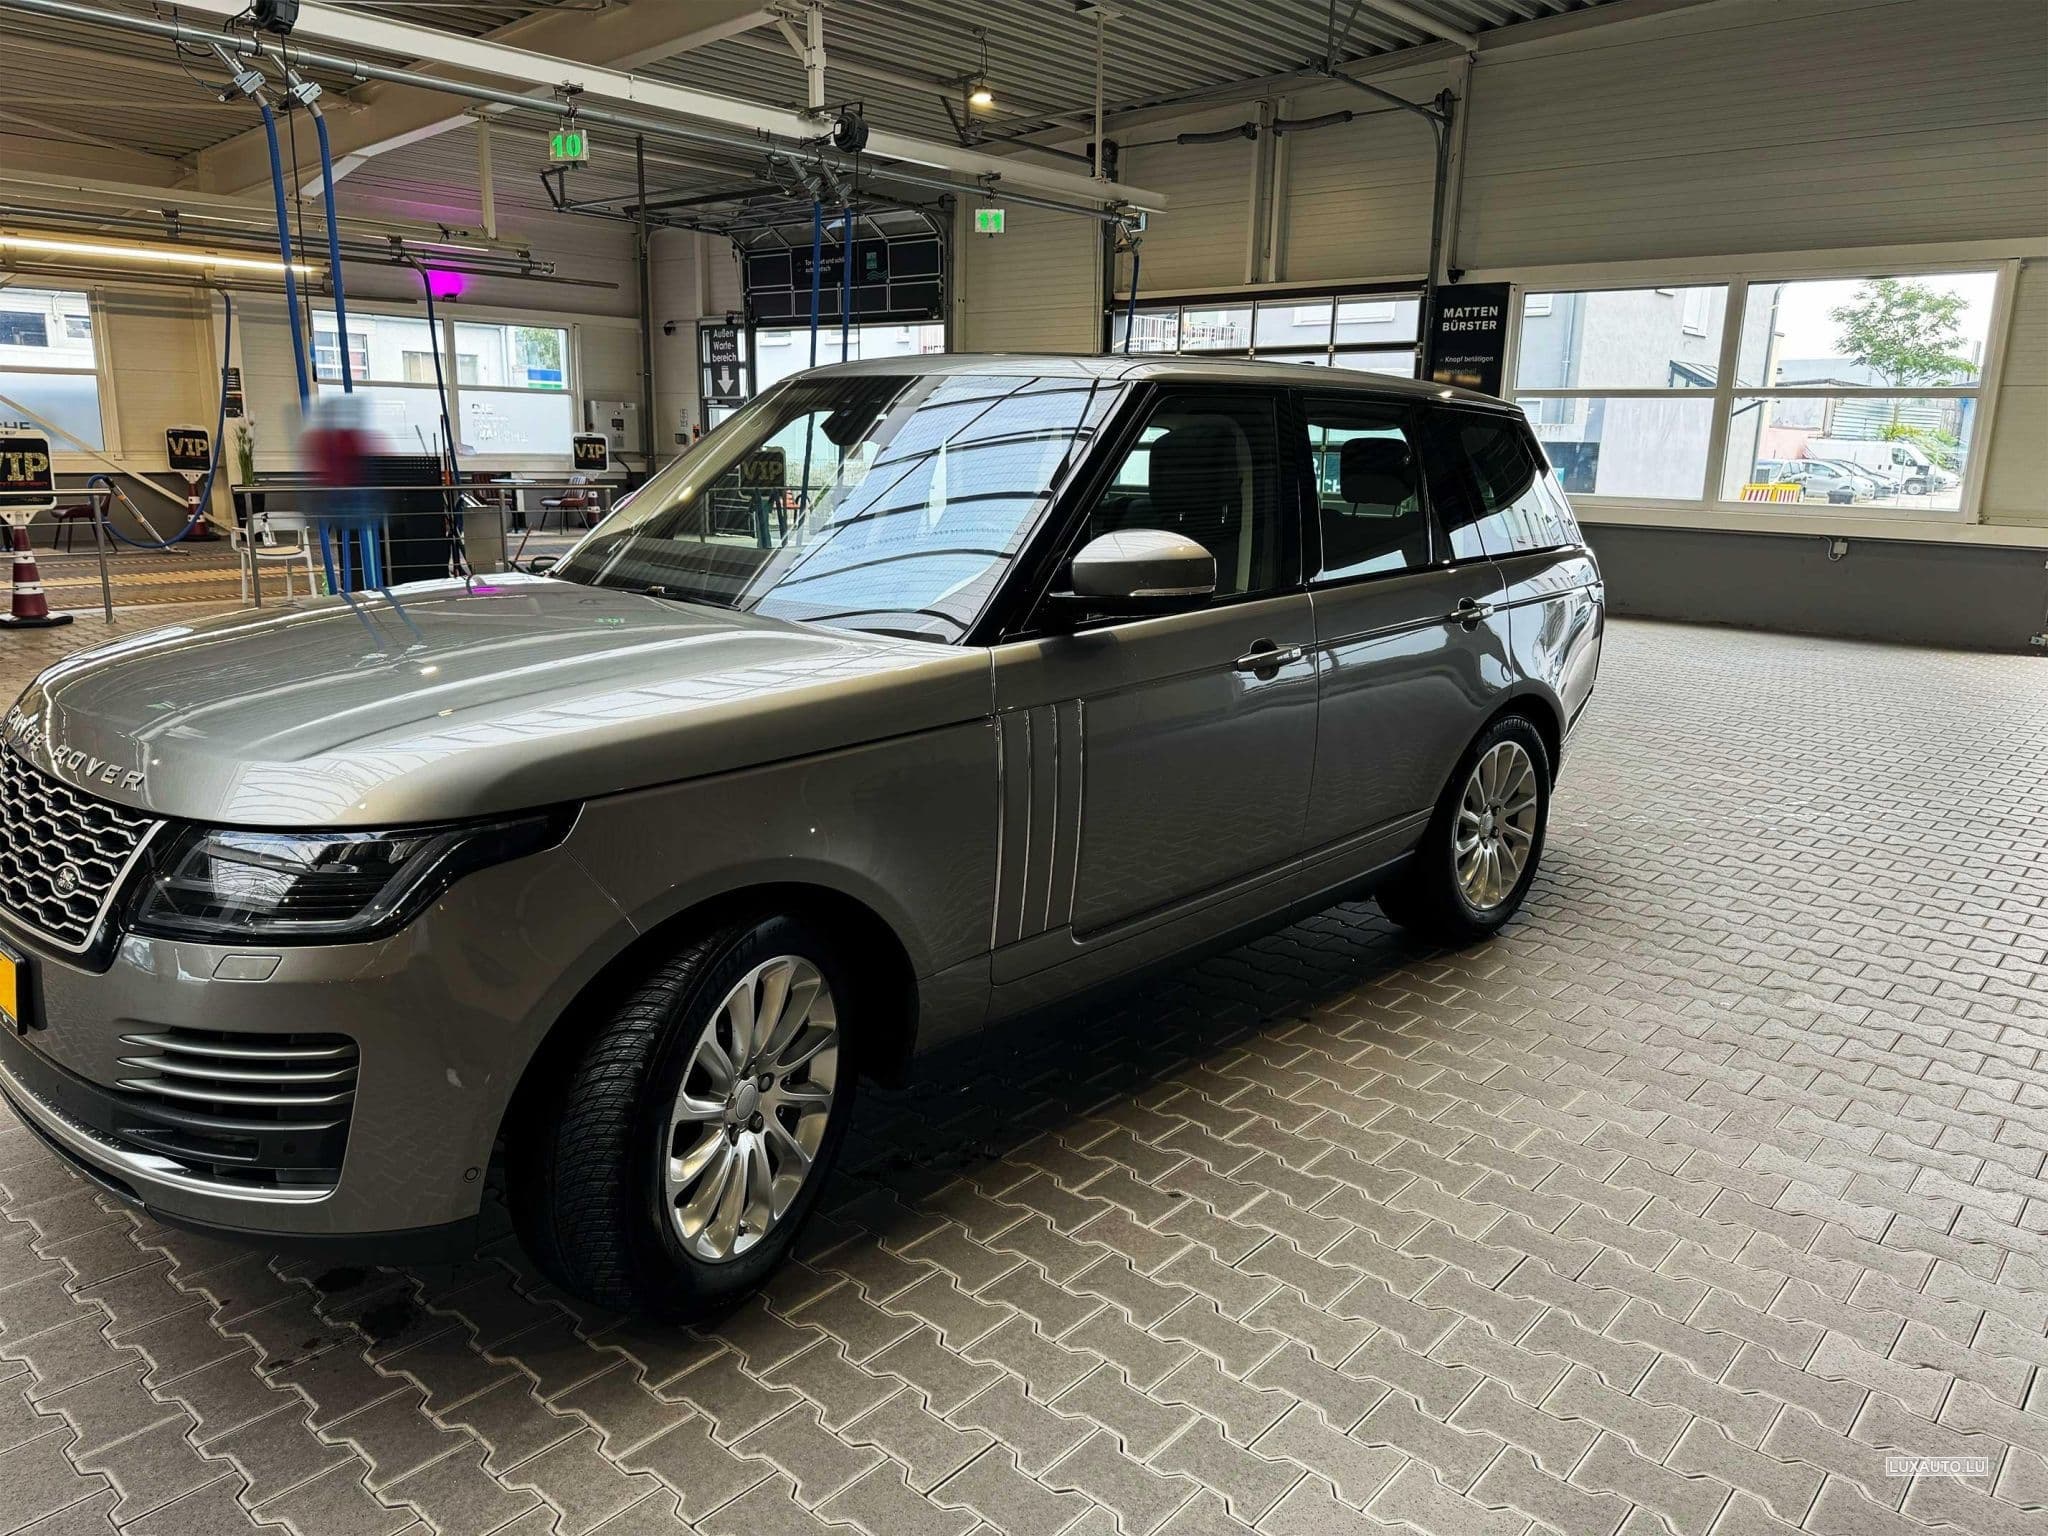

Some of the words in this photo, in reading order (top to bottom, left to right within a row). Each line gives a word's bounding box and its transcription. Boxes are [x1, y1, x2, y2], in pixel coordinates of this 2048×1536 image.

[552, 134, 581, 157] 10
[978, 211, 1002, 231] 11
[1443, 306, 1498, 318] MATTEN
[713, 328, 734, 338] Außen
[1442, 320, 1497, 331] BÜRSTER
[712, 353, 737, 362] bereich
[1445, 355, 1463, 363] Knopf
[168, 437, 208, 456] VIP
[575, 443, 606, 459] VIP
[741, 460, 783, 480] VIP
[53, 744, 145, 792] ROVER
